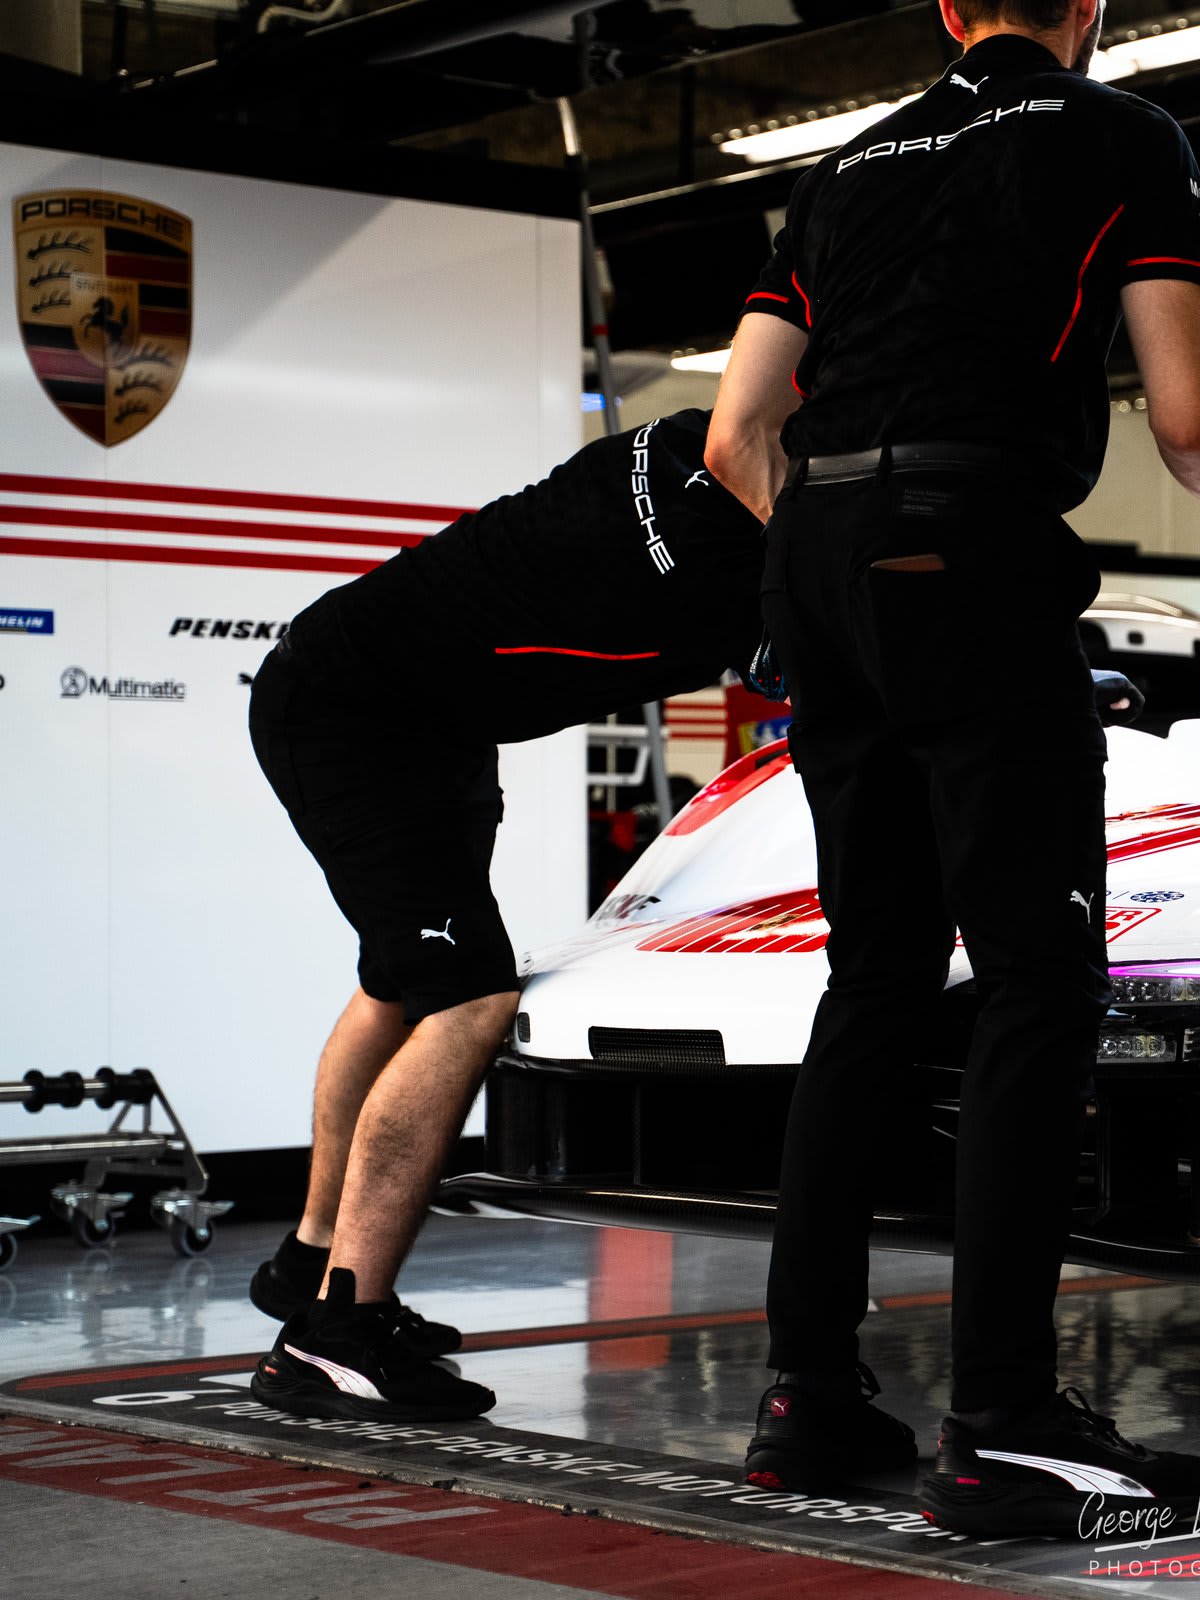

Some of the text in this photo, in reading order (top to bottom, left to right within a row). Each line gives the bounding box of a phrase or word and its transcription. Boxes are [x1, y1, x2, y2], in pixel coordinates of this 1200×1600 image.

[837, 100, 1065, 174] PORSCHE
[21, 198, 184, 243] PORSCHE
[89, 677, 186, 700] Multimatic
[405, 1435, 644, 1475] PENSKE
[607, 1470, 1036, 1546] MOTORSPO
